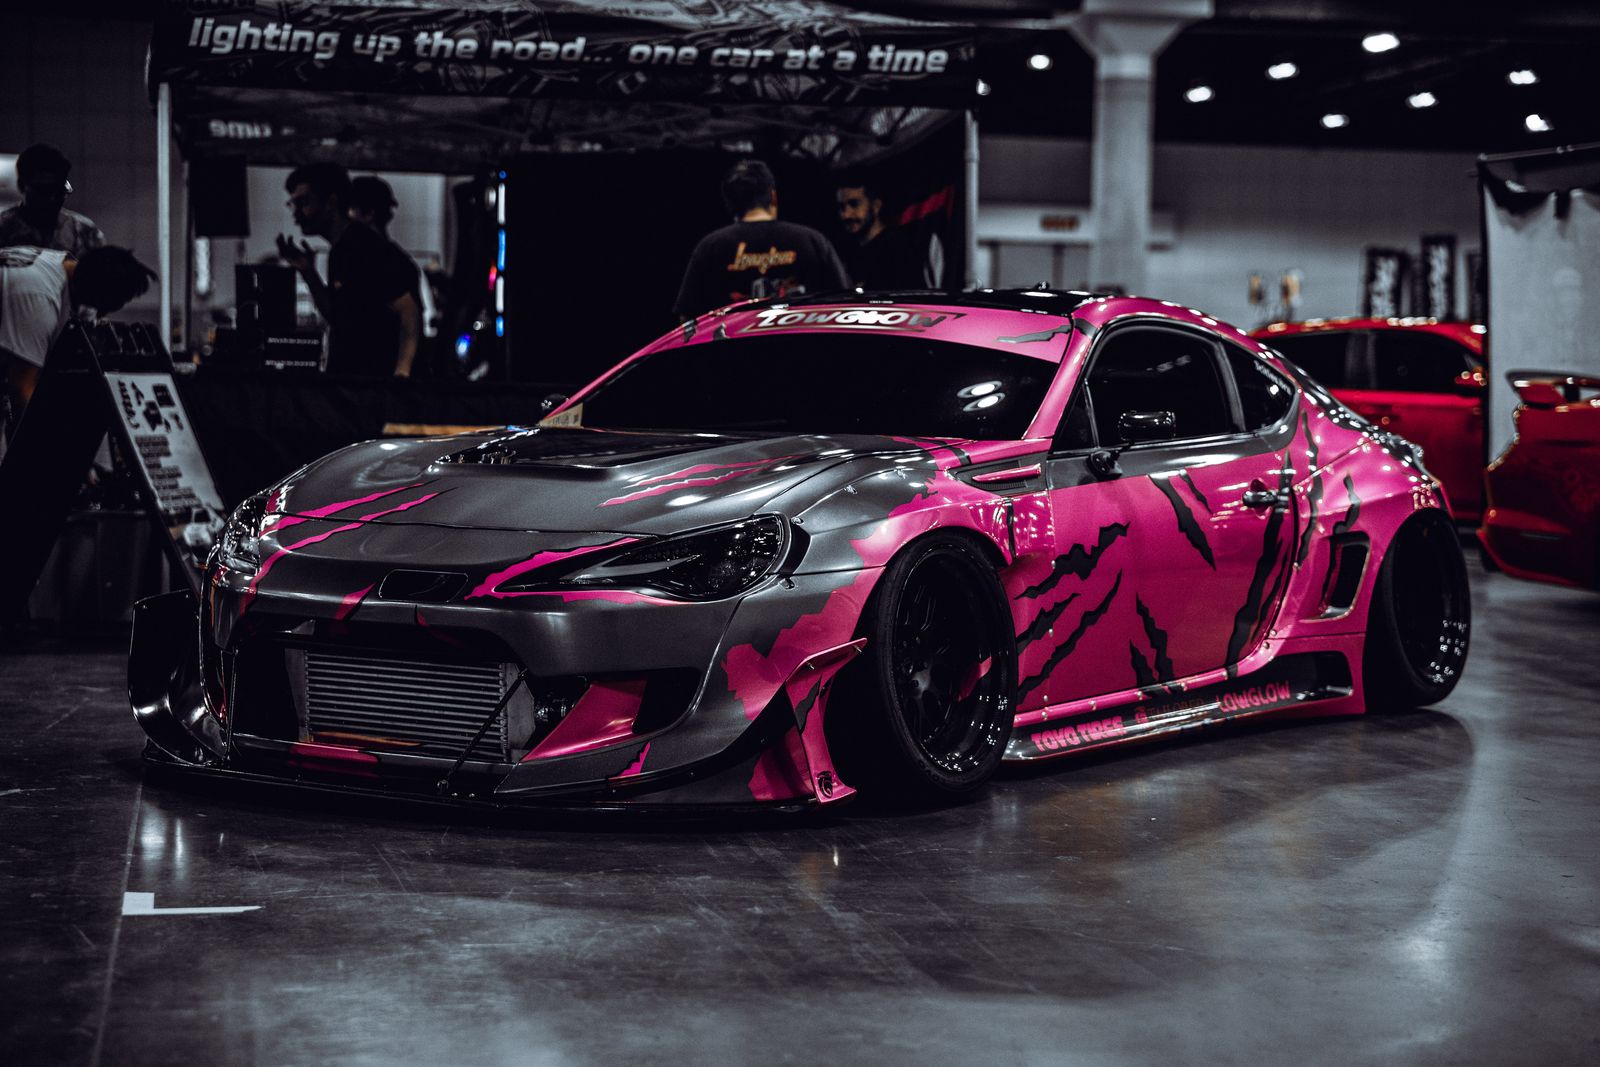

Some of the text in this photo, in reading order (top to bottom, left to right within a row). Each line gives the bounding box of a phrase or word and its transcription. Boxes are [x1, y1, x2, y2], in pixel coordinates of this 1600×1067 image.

[188, 17, 341, 60] lighting
[353, 33, 401, 63] up
[413, 31, 477, 60] the
[628, 43, 699, 67] one
[709, 46, 774, 70] car
[782, 46, 826, 71] at
[832, 49, 858, 72] a
[867, 44, 950, 74] time
[1216, 680, 1291, 712] LOWGLOW
[1031, 726, 1081, 752] TOYO
